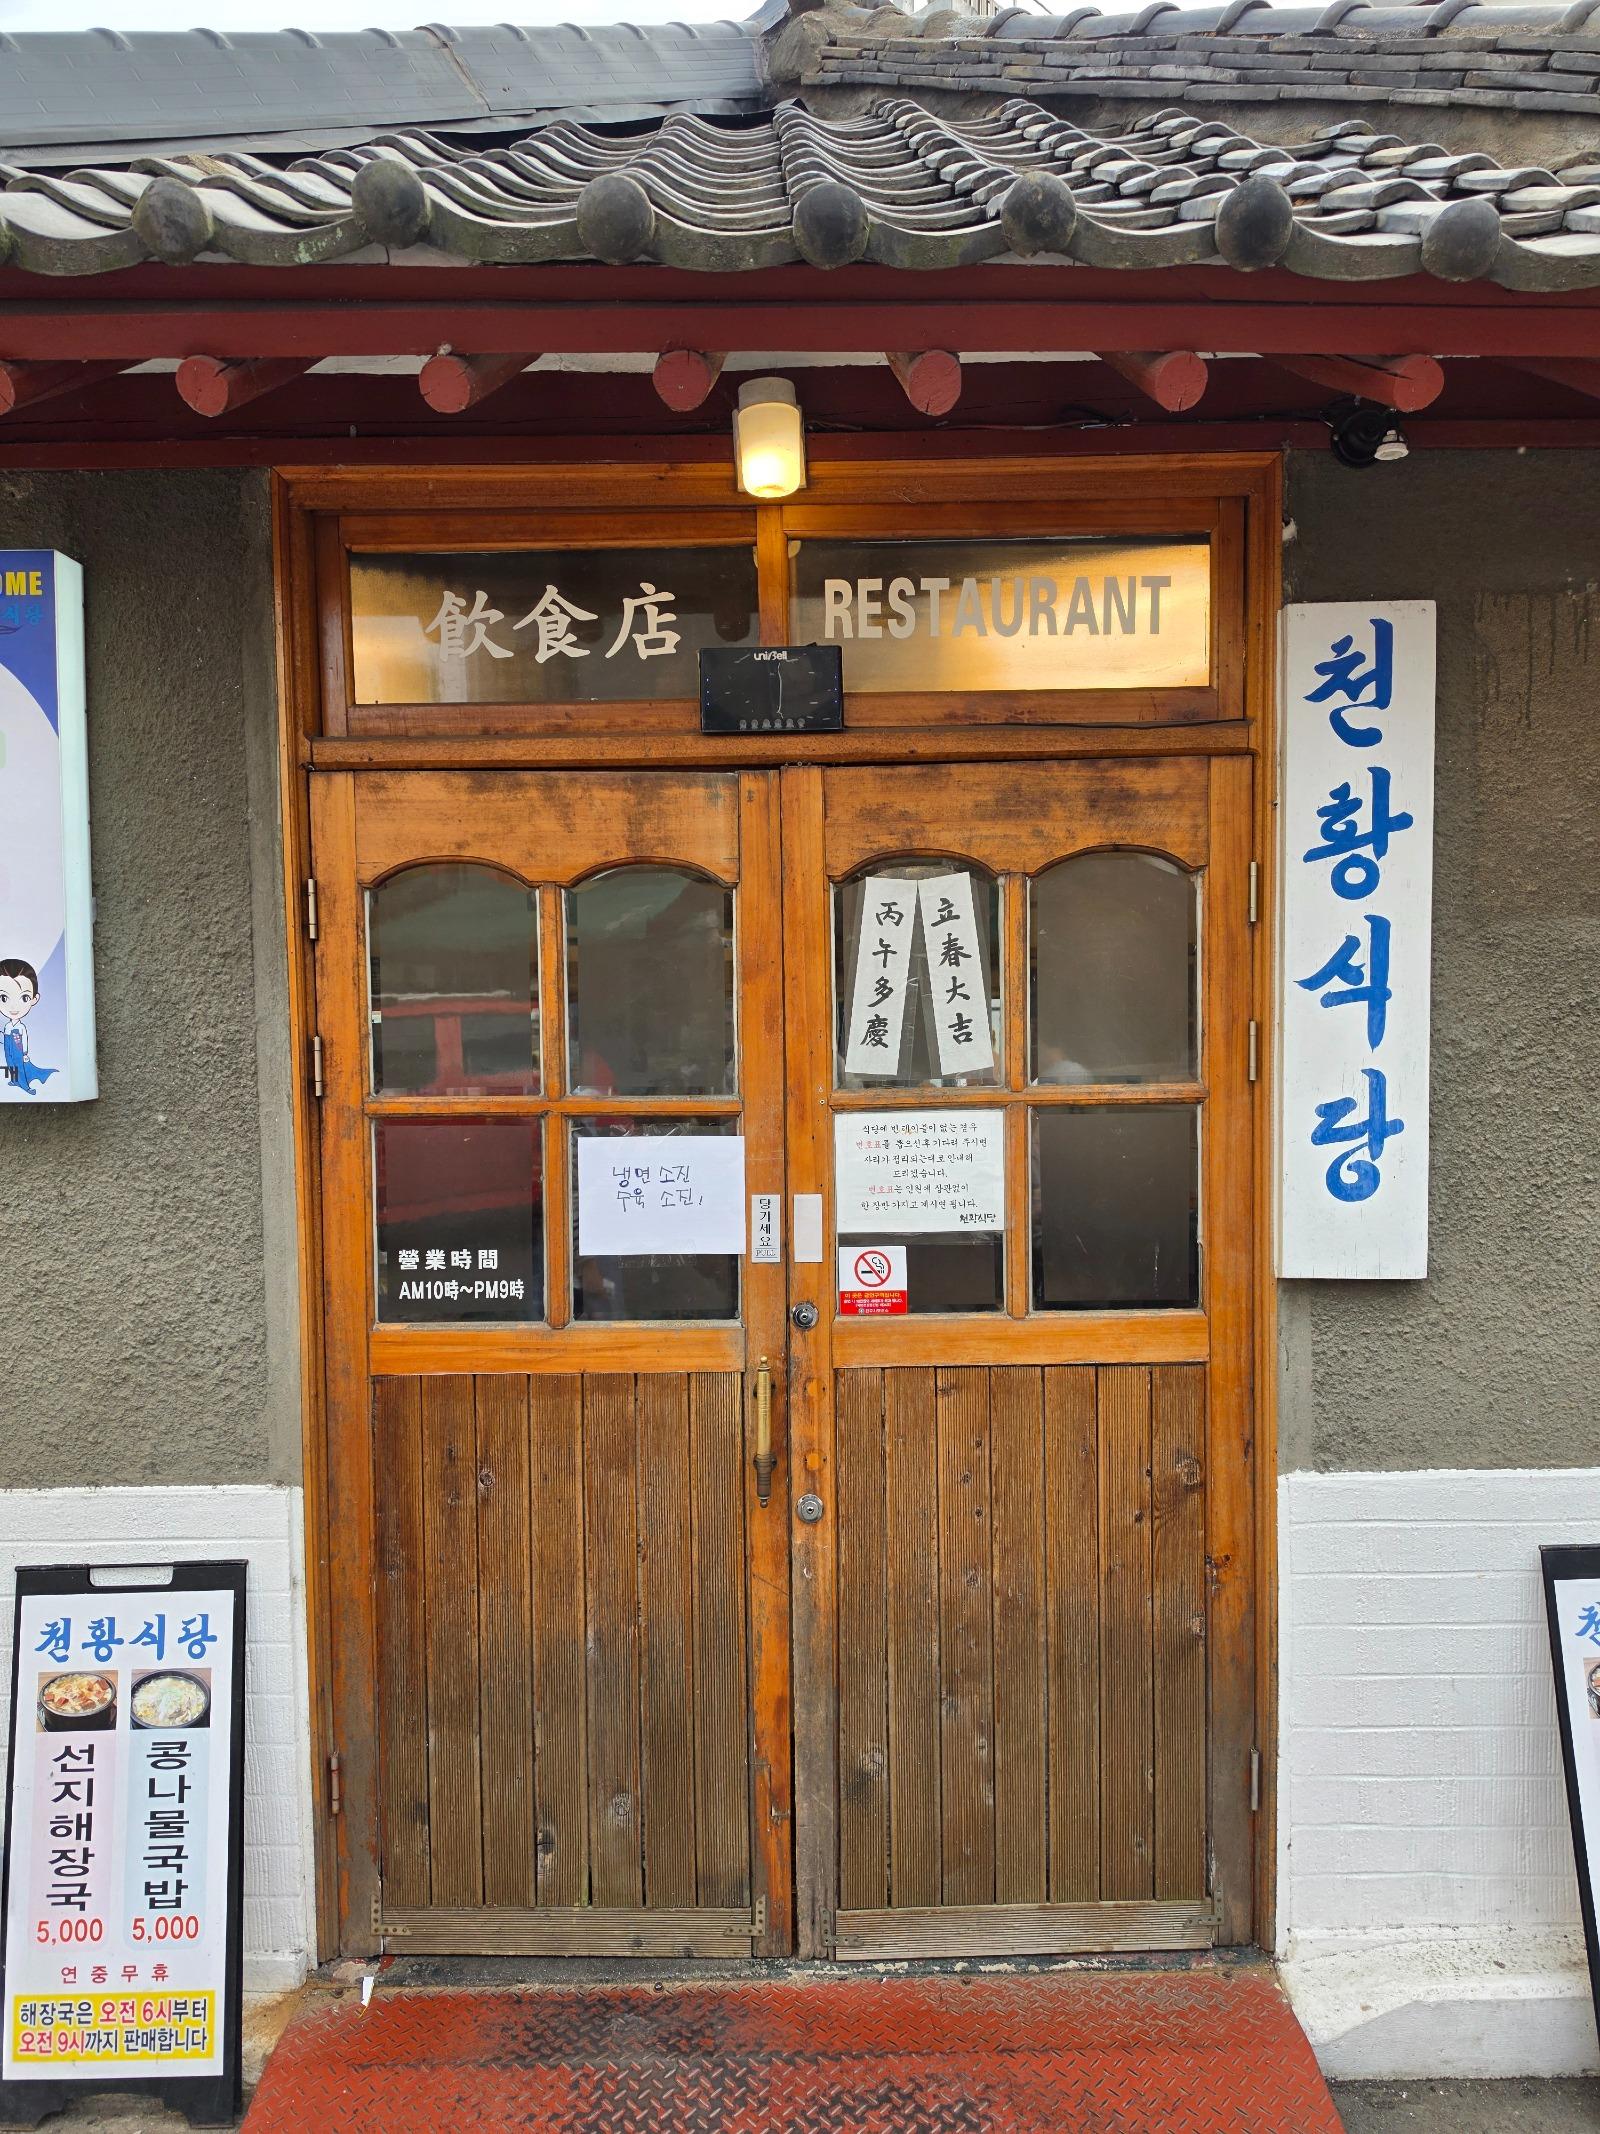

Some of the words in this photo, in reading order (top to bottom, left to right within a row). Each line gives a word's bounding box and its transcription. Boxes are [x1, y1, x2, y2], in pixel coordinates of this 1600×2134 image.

[824, 576, 1172, 638] RESTAURANT
[425, 582, 682, 664] 飲食店
[1293, 617, 1413, 1203] 천황식당
[860, 901, 904, 1048] 丙午多慶
[931, 898, 973, 1045] 立春大吉
[863, 1124, 887, 1136] 식당에
[962, 1137, 987, 1148] 주시면
[612, 1166, 650, 1188] 냉면
[659, 1165, 690, 1183] 소진
[892, 1168, 948, 1179] 드리겠습니다.
[759, 1198, 772, 1247] 당기세요
[398, 1249, 498, 1270] 營業時間
[756, 1249, 776, 1257] PULL
[34, 1613, 218, 1663] 천황식당
[45, 1743, 96, 1912] 선지해장국
[143, 1740, 192, 1910] 콩나물국밥
[36, 1918, 103, 1946] 5,000
[132, 1915, 199, 1943] 5,000
[20, 2001, 93, 2026] 해장국은
[99, 2000, 136, 2024] 오전
[142, 1999, 207, 2024] 6시부터
[19, 2031, 52, 2054] 오전
[57, 2030, 118, 2053] 9시까지
[124, 2028, 207, 2052] 판매합니다
